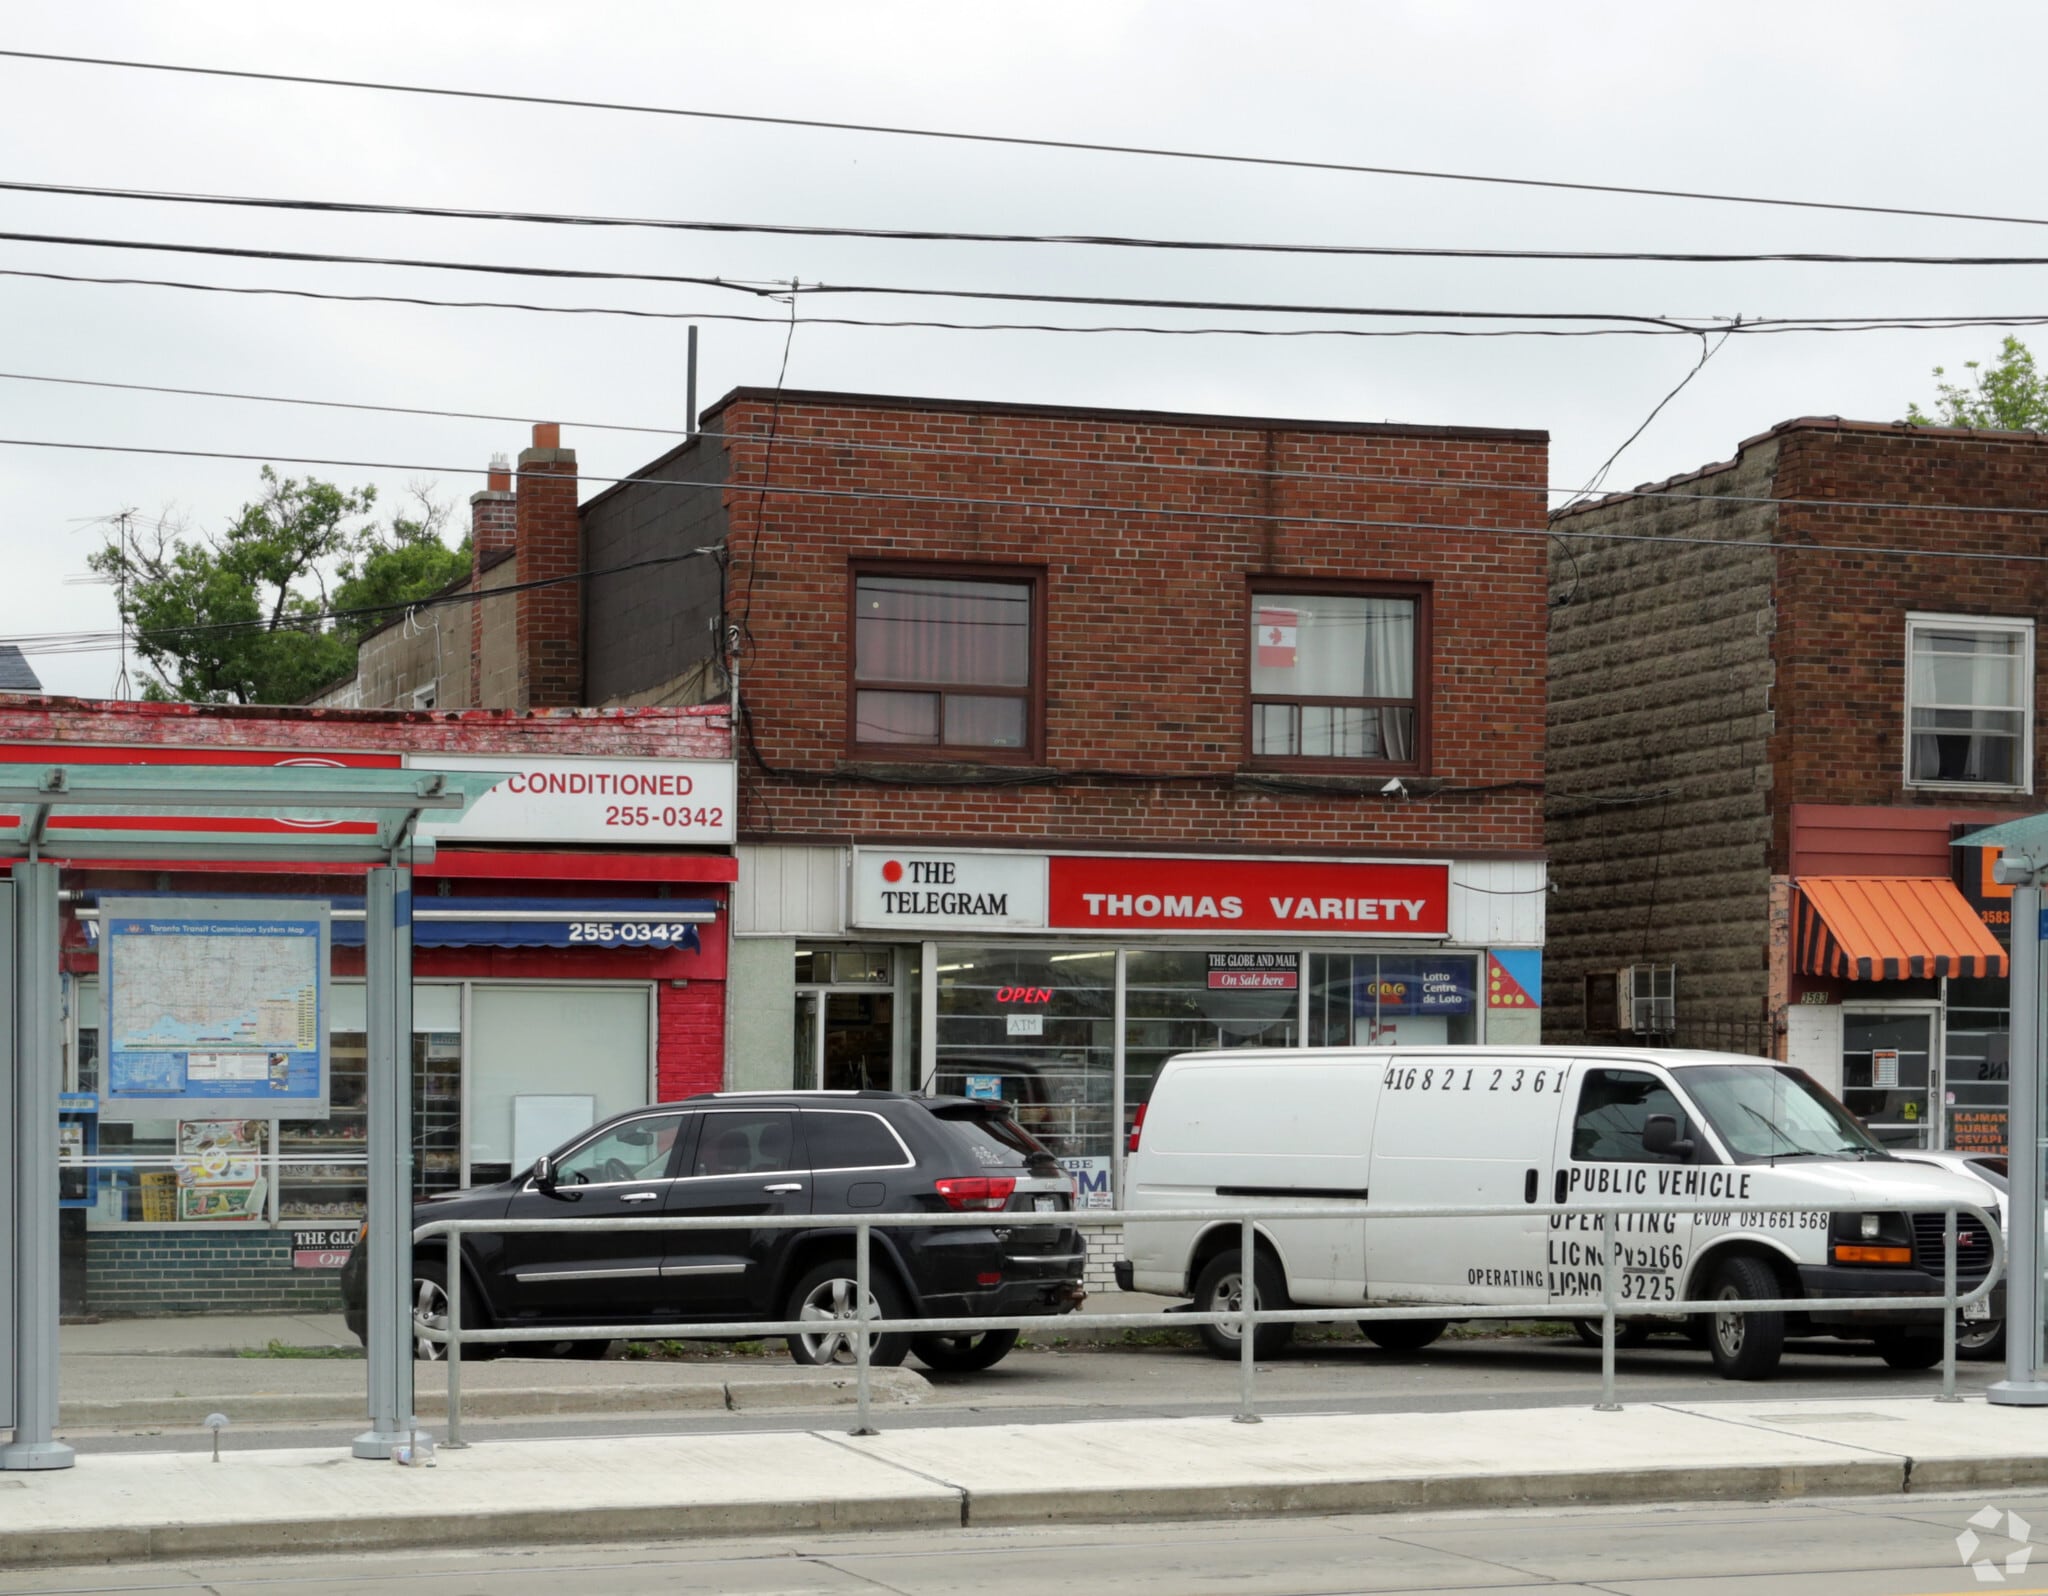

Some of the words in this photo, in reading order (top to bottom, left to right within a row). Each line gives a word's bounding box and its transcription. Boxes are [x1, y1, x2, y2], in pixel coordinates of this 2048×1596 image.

[508, 772, 693, 796] CONDITIONED
[605, 806, 723, 828] 255-0342
[908, 861, 956, 885] THE
[881, 891, 1008, 916] TELEGRAM
[1082, 893, 1243, 919] THOMAS
[1269, 896, 1426, 921] VARIETY
[1980, 911, 2011, 924] 3583
[150, 924, 180, 934] Toronto
[182, 924, 209, 934] Transit
[210, 924, 257, 934] Commission
[258, 925, 286, 936] System
[287, 926, 305, 936] Map
[1208, 953, 1226, 967] THE
[1227, 953, 1256, 967] GLOBE
[1256, 953, 1274, 967] AND
[1275, 953, 1297, 968] MAIL
[1221, 974, 1237, 986] On
[1239, 973, 1261, 986] Sale
[1422, 972, 1451, 982] Lotto
[997, 985, 1053, 1004] OPEN
[1422, 983, 1457, 993] Centre
[1422, 994, 1436, 1004] de
[1438, 994, 1463, 1004] Loto
[1801, 991, 1829, 1005] 3583
[1010, 1018, 1037, 1032] ATM
[1954, 1112, 2008, 1122] KAJMAK
[1954, 1123, 2000, 1133] BUREK
[1954, 1134, 2003, 1144] CEVAPI
[1569, 1167, 1647, 1195] PUBLIC
[1657, 1169, 1751, 1200] VEHICLE
[1693, 1211, 1731, 1228] CVOR
[294, 1231, 327, 1245] THE
[329, 1231, 359, 1245] GLO
[319, 1253, 347, 1266] On
[1467, 1267, 1544, 1288] OPERATING
[1620, 1273, 1676, 1302] 3225
